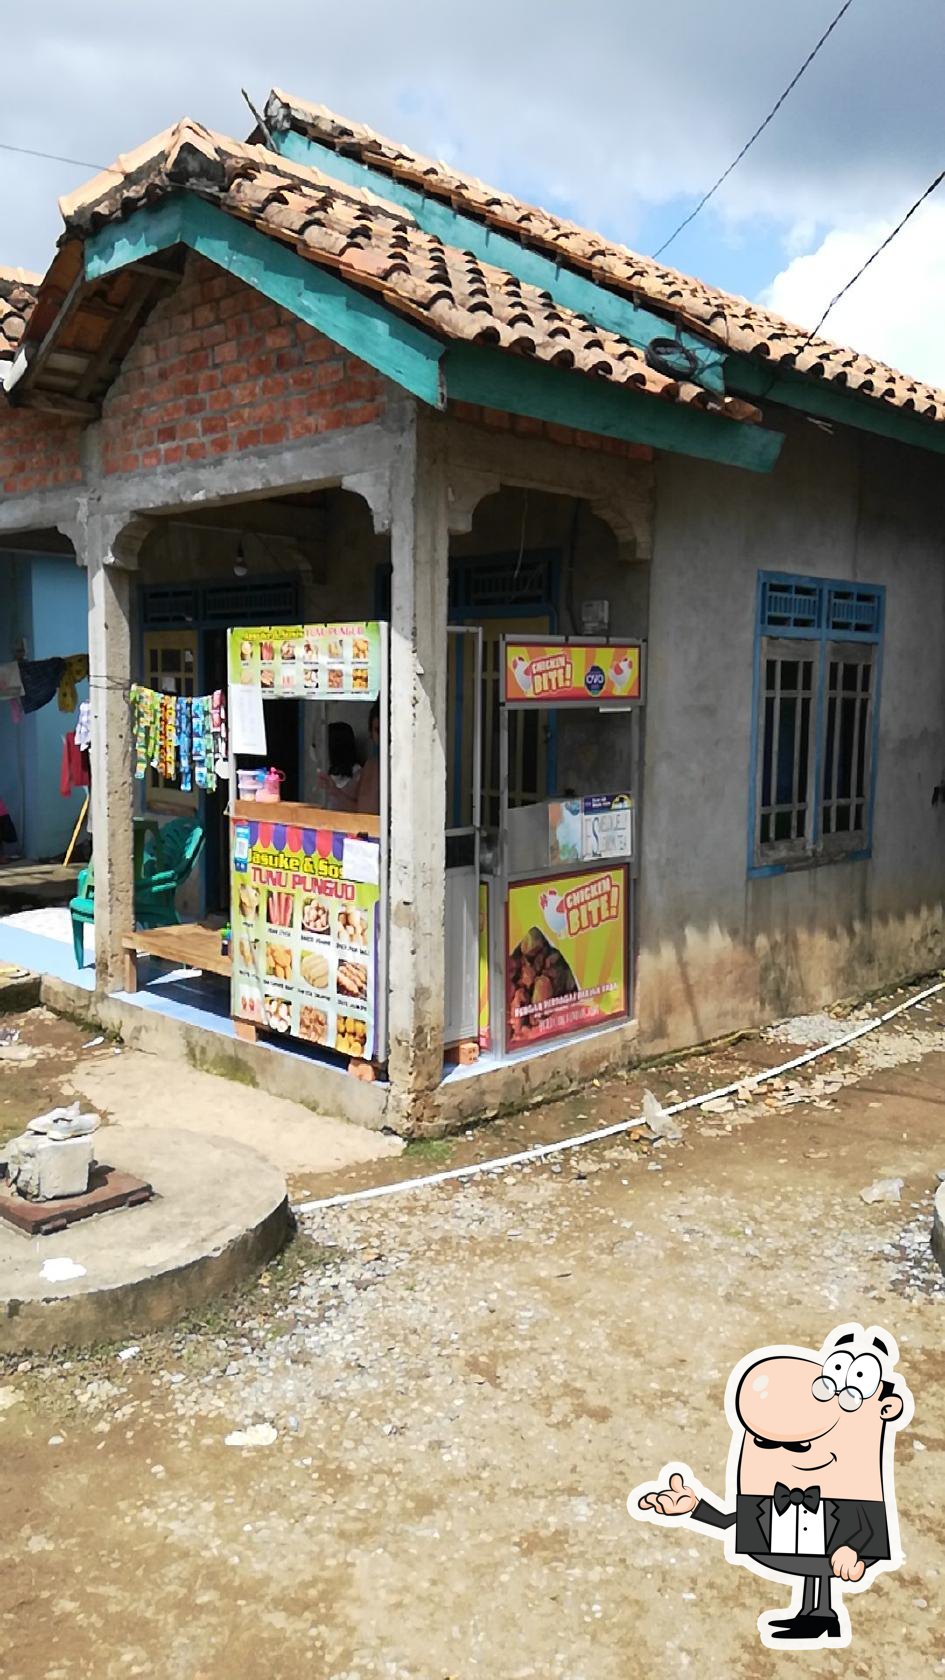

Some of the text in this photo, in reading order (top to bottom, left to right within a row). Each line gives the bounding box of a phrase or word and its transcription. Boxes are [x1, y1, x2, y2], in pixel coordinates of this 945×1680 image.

[533, 662, 572, 695] BITE!
[303, 856, 316, 875] &
[568, 885, 619, 936] BITE!
